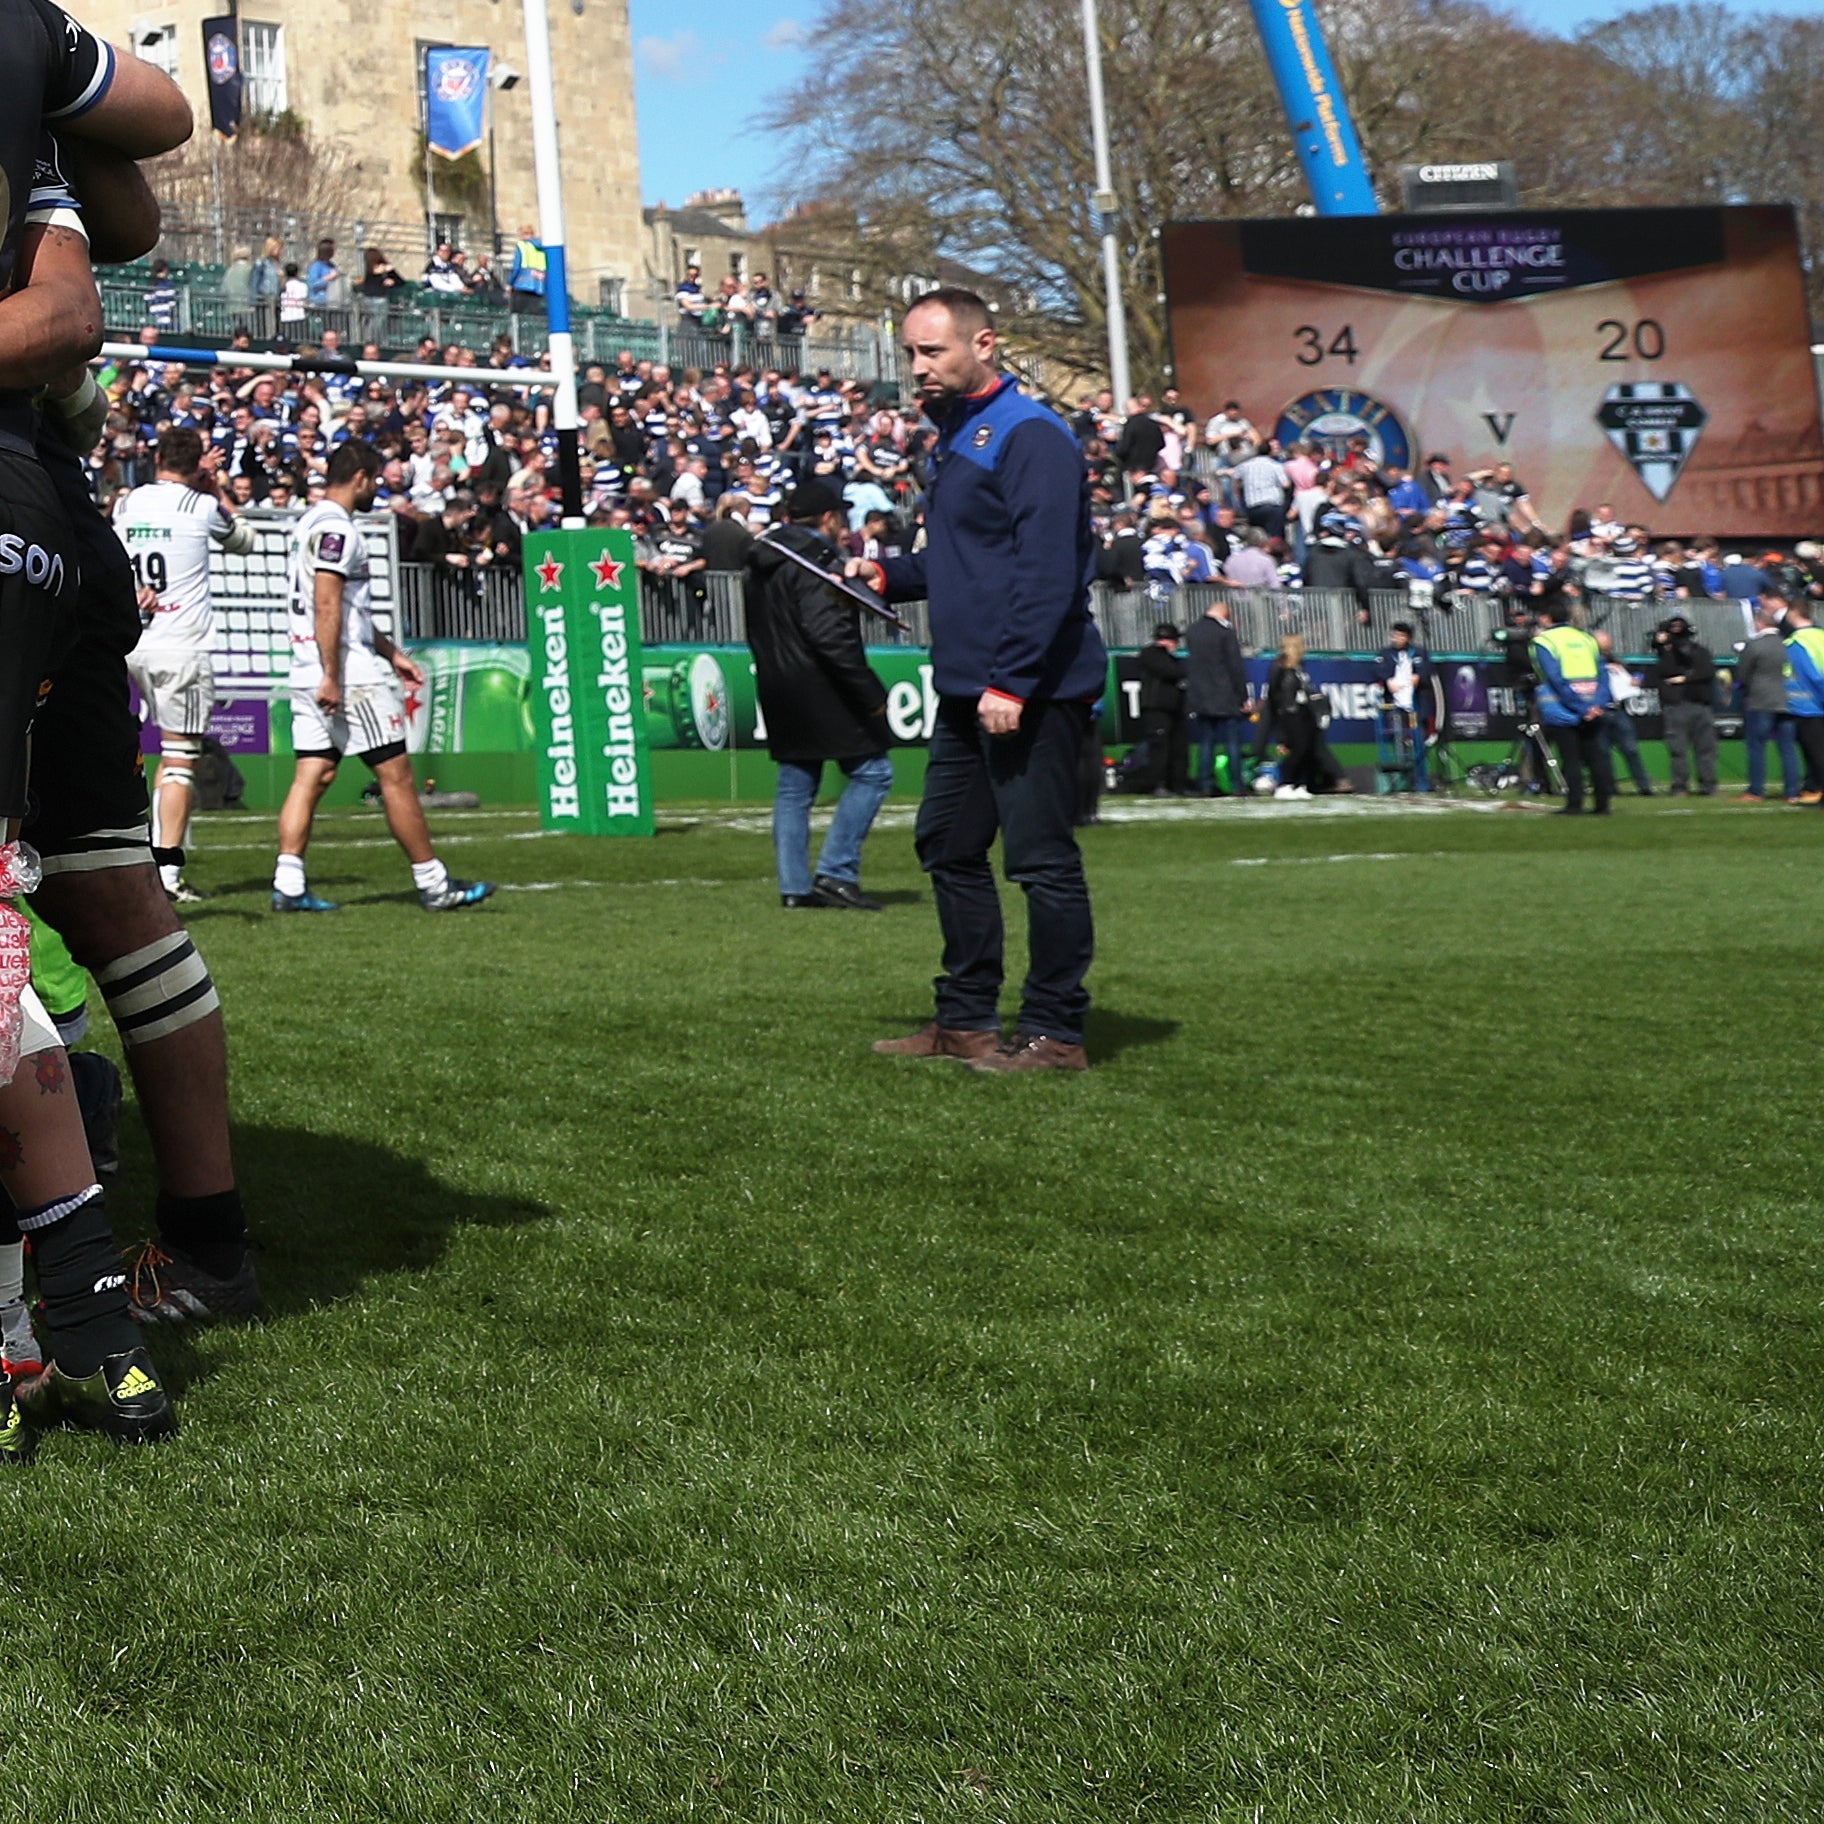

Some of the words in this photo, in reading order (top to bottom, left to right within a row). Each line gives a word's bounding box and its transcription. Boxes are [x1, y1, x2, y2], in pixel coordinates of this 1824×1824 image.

[1394, 244, 1566, 270] CHALLENGE
[1452, 270, 1510, 293] CUP
[1293, 325, 1359, 366] 34
[1597, 320, 1666, 362] 20
[542, 604, 580, 819] Heineken
[597, 603, 640, 818] Heineken
[116, 1380, 157, 1400] adidas
